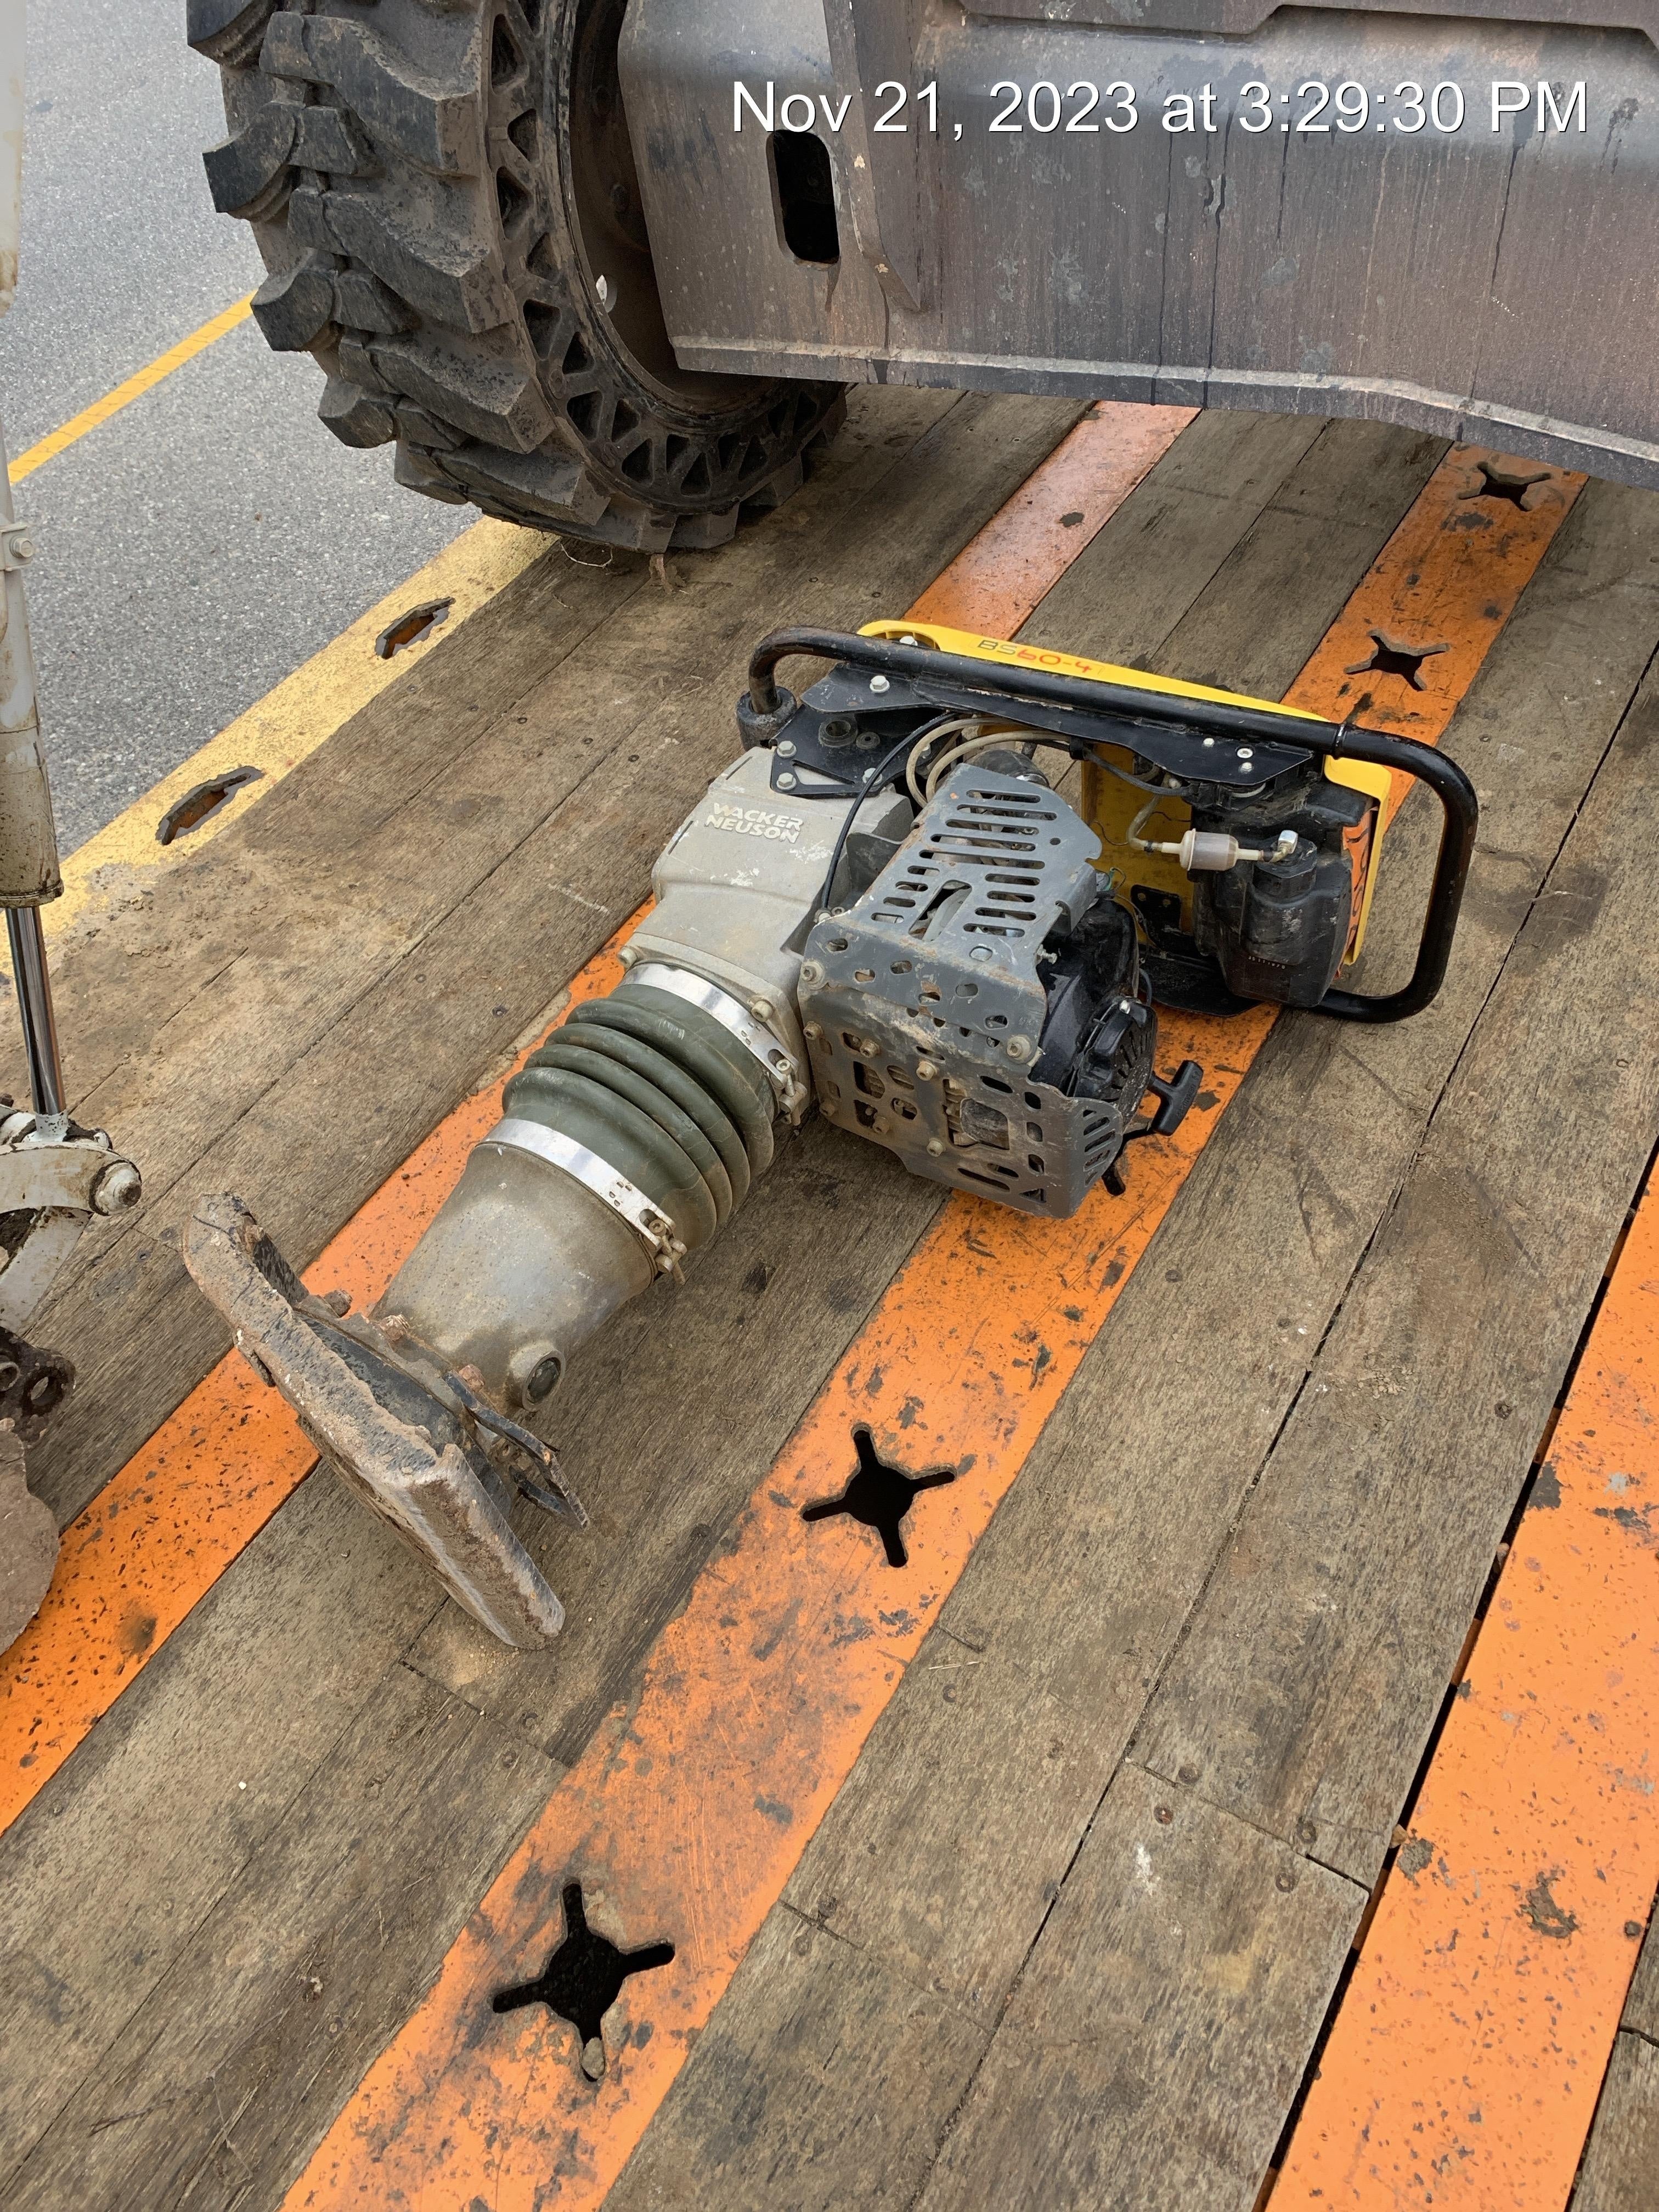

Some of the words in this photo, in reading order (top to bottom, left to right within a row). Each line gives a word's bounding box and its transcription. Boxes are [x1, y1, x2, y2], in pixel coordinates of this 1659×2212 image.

[978, 639, 1092, 673] BS60-4
[704, 815, 800, 844] NEUSON
[713, 803, 804, 832] WACKER
